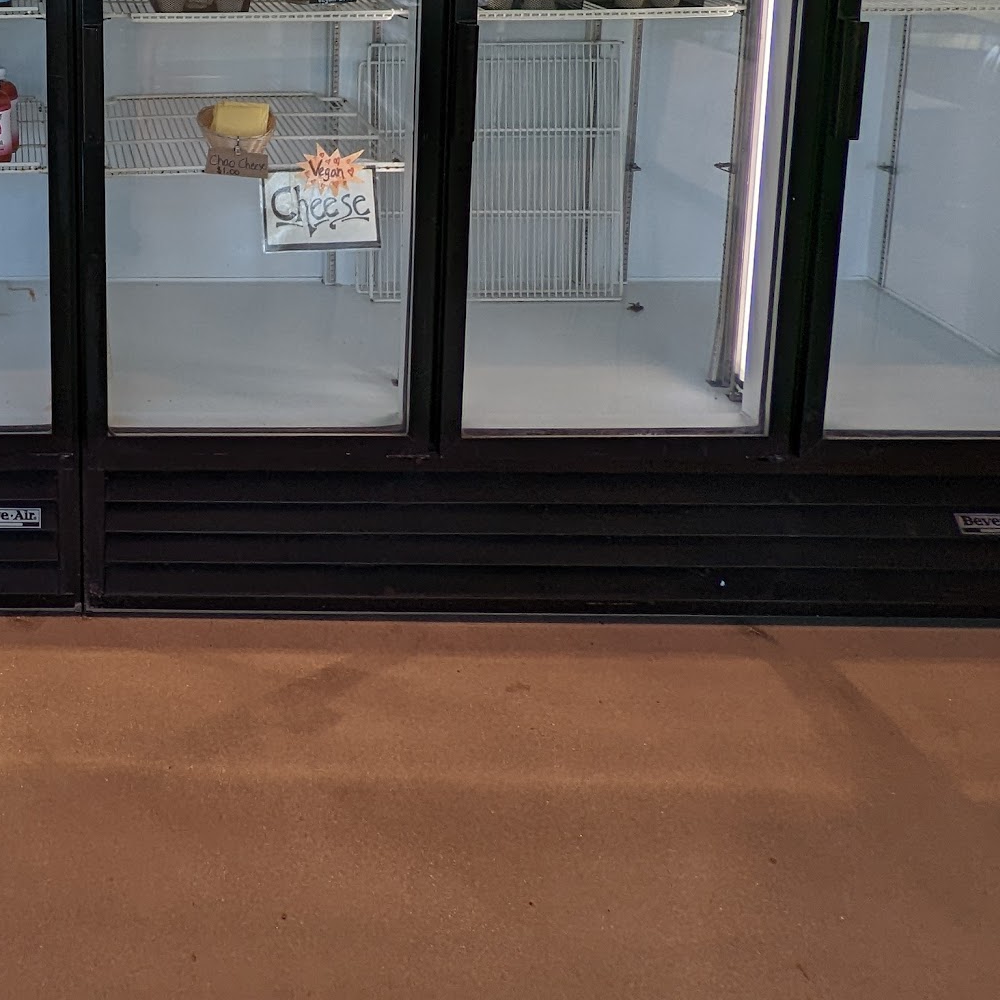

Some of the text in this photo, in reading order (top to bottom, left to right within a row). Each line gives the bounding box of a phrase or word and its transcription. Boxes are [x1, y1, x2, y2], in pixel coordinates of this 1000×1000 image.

[216, 165, 240, 176] $1.00
[308, 159, 345, 182] Vegan
[271, 185, 371, 238] Cheese
